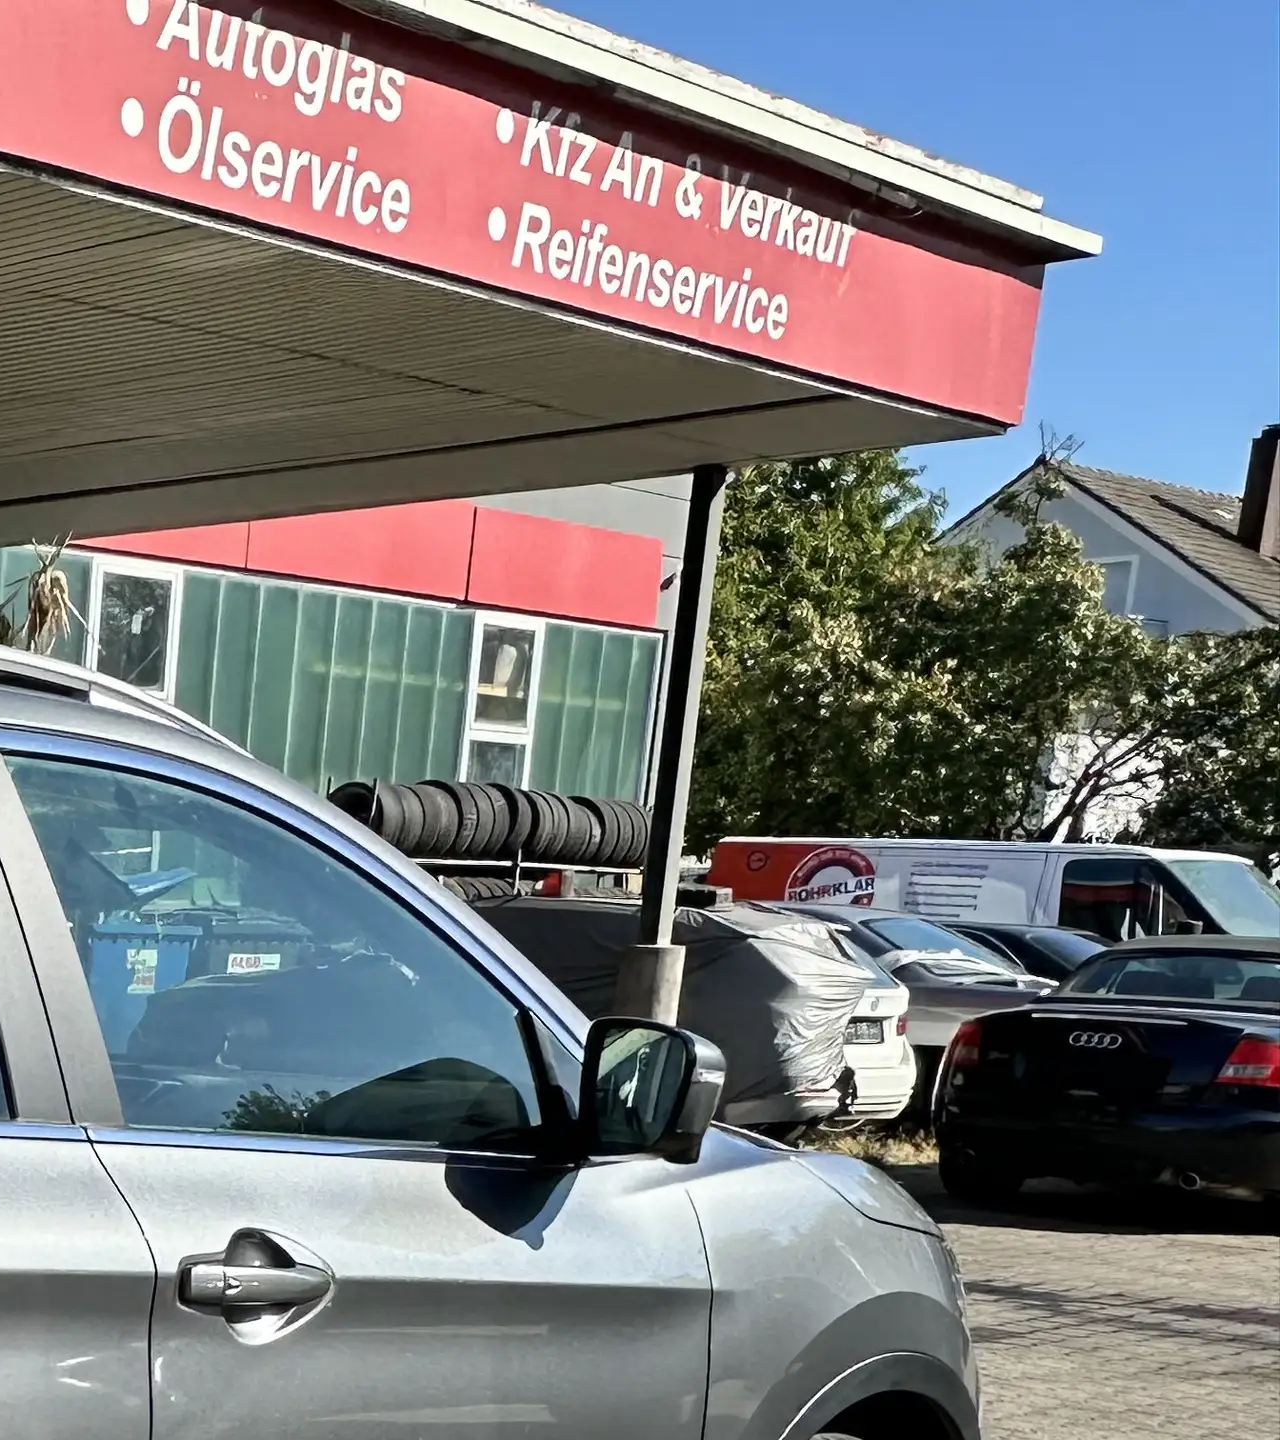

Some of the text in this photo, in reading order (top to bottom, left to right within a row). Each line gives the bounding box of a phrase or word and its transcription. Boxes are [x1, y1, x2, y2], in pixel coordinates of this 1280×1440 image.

[156, 0, 406, 123] Autoglas
[158, 76, 411, 233] Ölservice
[520, 100, 861, 267] Kfz An & Verkauf
[511, 202, 789, 339] Reifenservice
